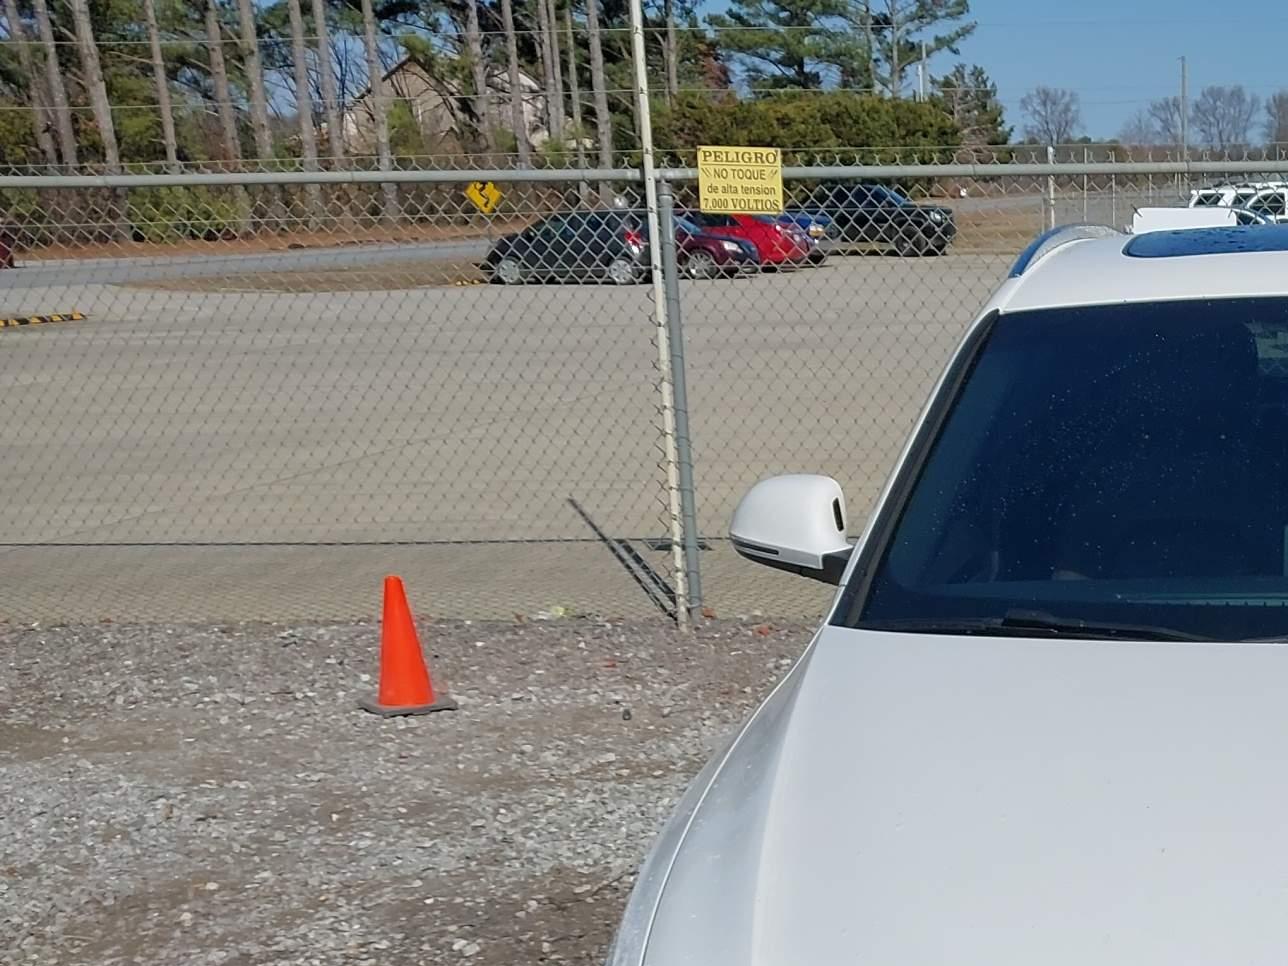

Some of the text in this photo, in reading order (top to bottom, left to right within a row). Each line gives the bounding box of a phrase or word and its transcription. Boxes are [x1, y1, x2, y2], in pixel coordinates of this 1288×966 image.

[702, 150, 777, 165] PELIGRO
[713, 168, 766, 180] NO TOQUE
[707, 184, 776, 195] de alta tension
[704, 198, 780, 210] 7.000 VOLTIOS
